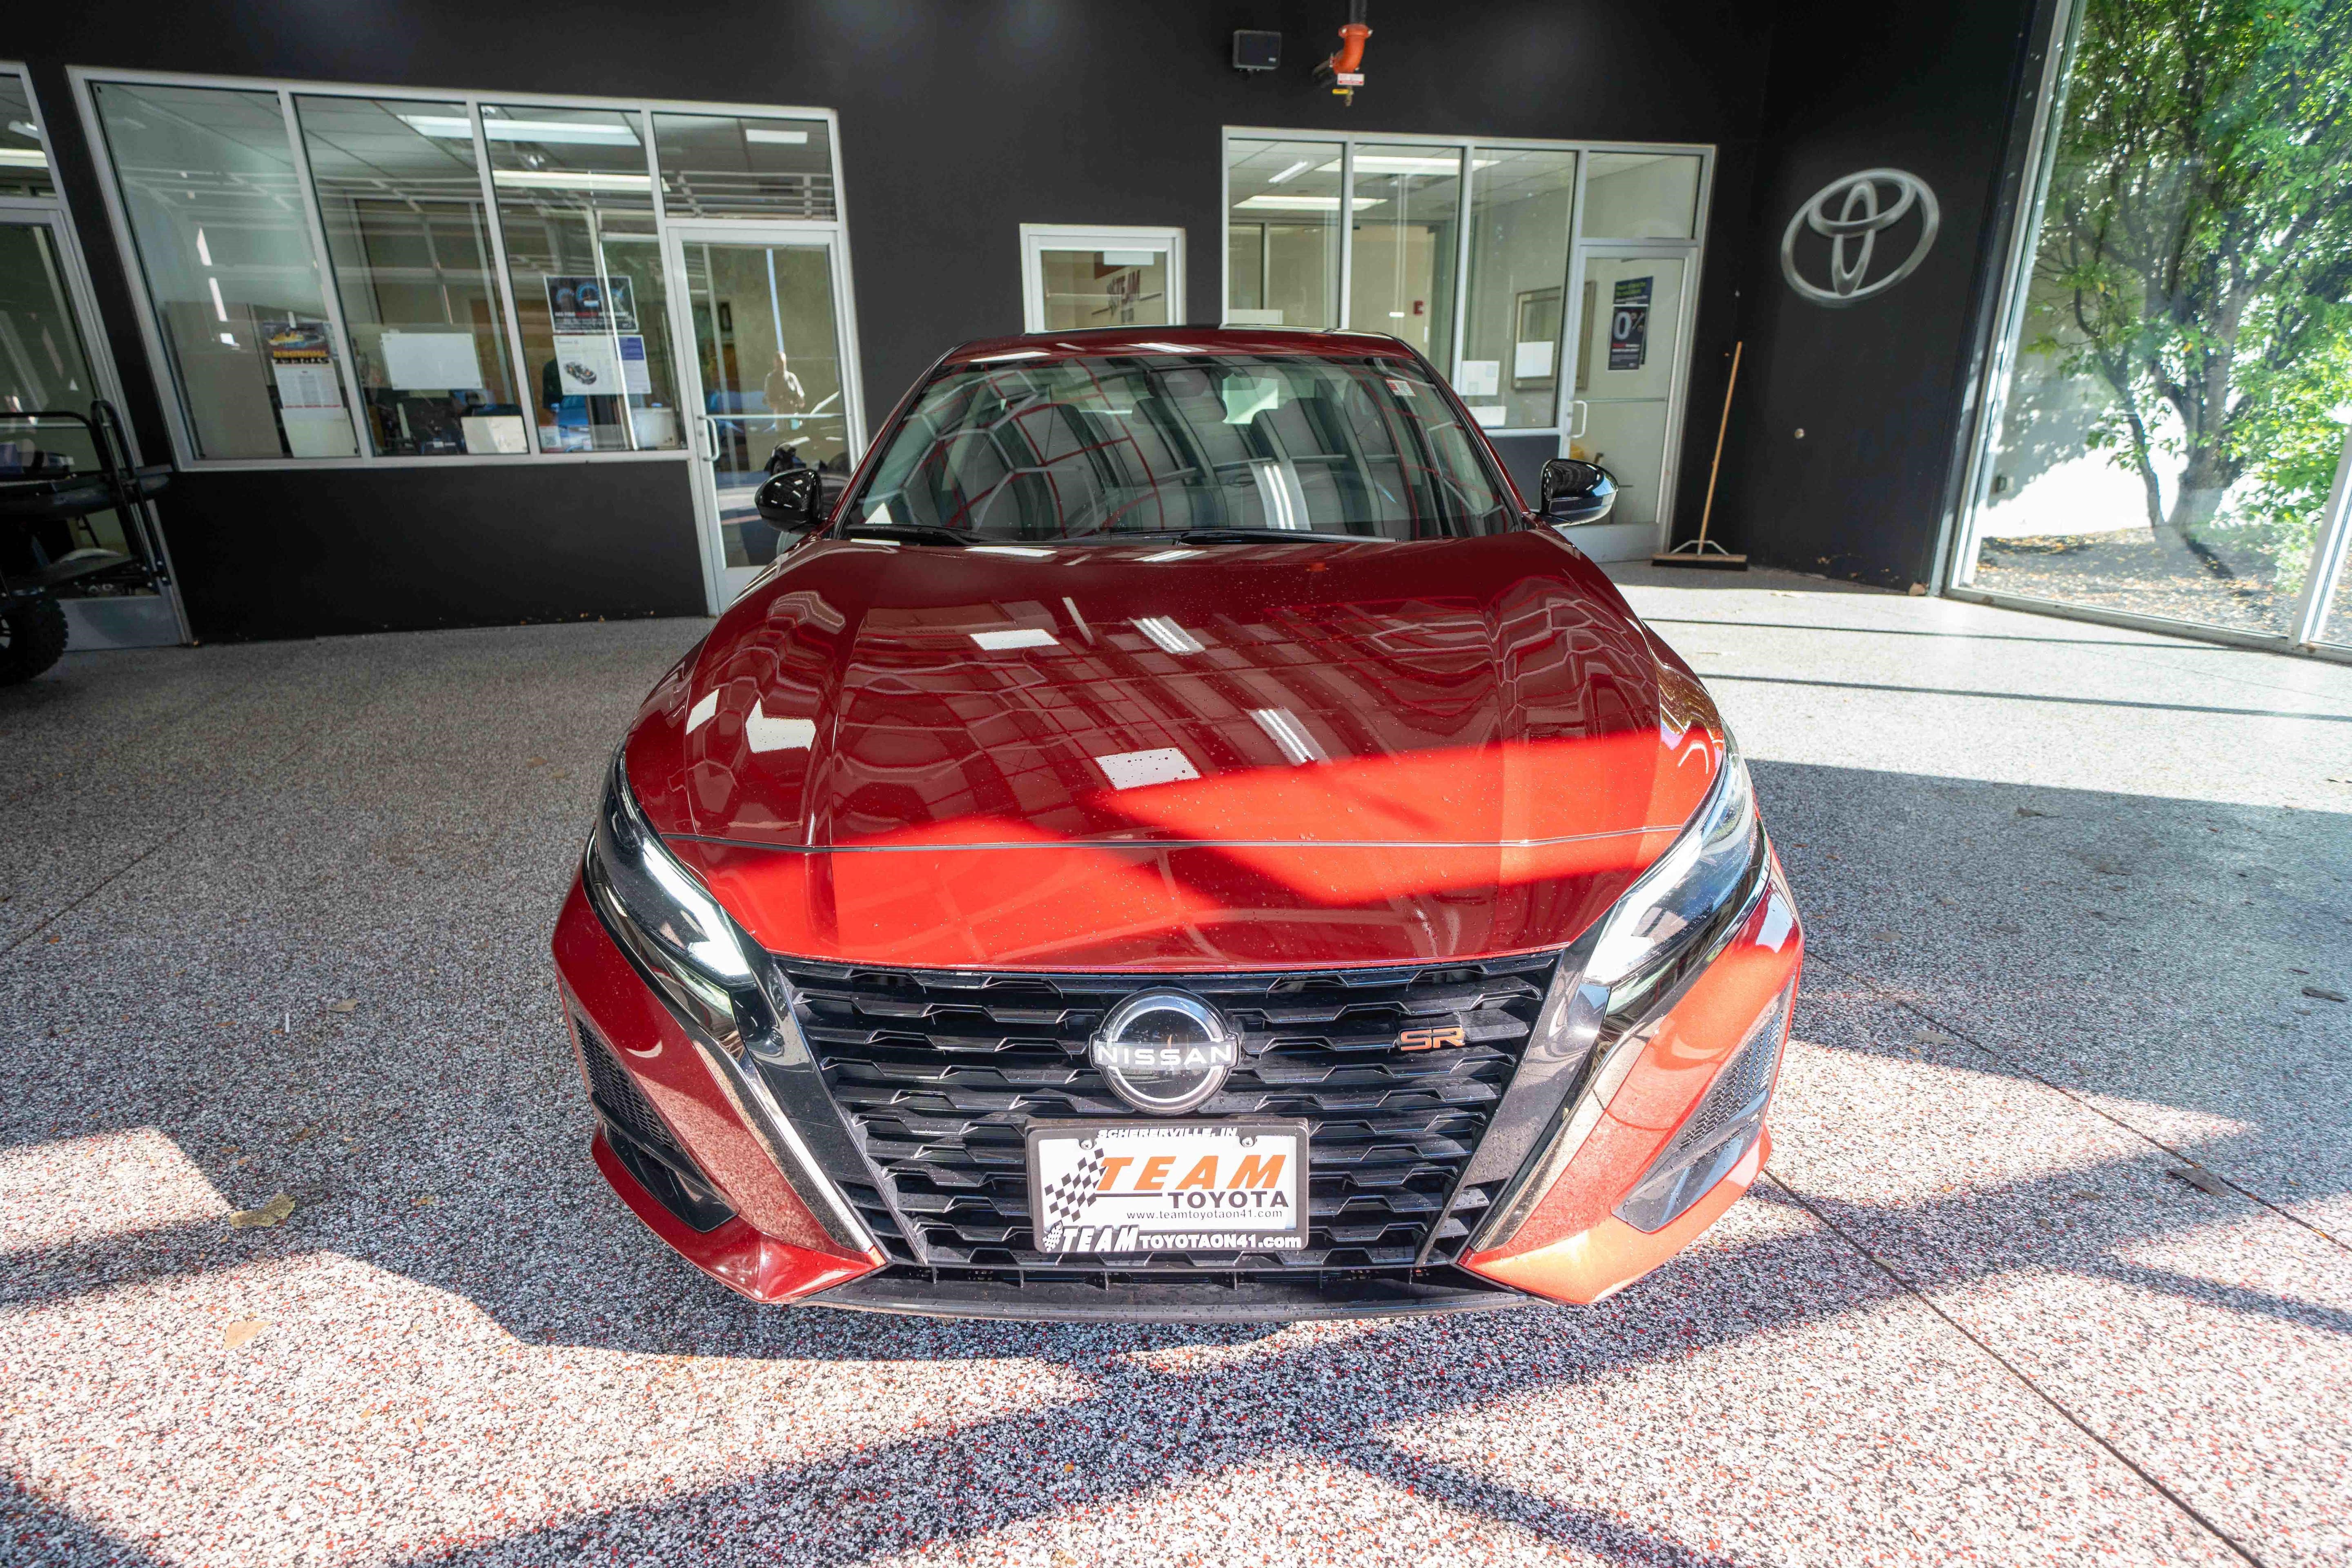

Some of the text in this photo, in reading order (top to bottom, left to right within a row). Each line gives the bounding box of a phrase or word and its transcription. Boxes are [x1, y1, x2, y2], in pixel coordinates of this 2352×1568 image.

[1401, 1027, 1465, 1051] SR
[1098, 1045, 1232, 1066] NISSAN
[1097, 1127, 1238, 1138] SCHERERVILLE, IN
[1097, 1155, 1286, 1191] TEAM
[1168, 1190, 1289, 1209] TOYOTA
[1127, 1209, 1283, 1221] www.teamtoyotaon41.com
[1062, 1227, 1302, 1252] TEAM TOYOTAON41.com
